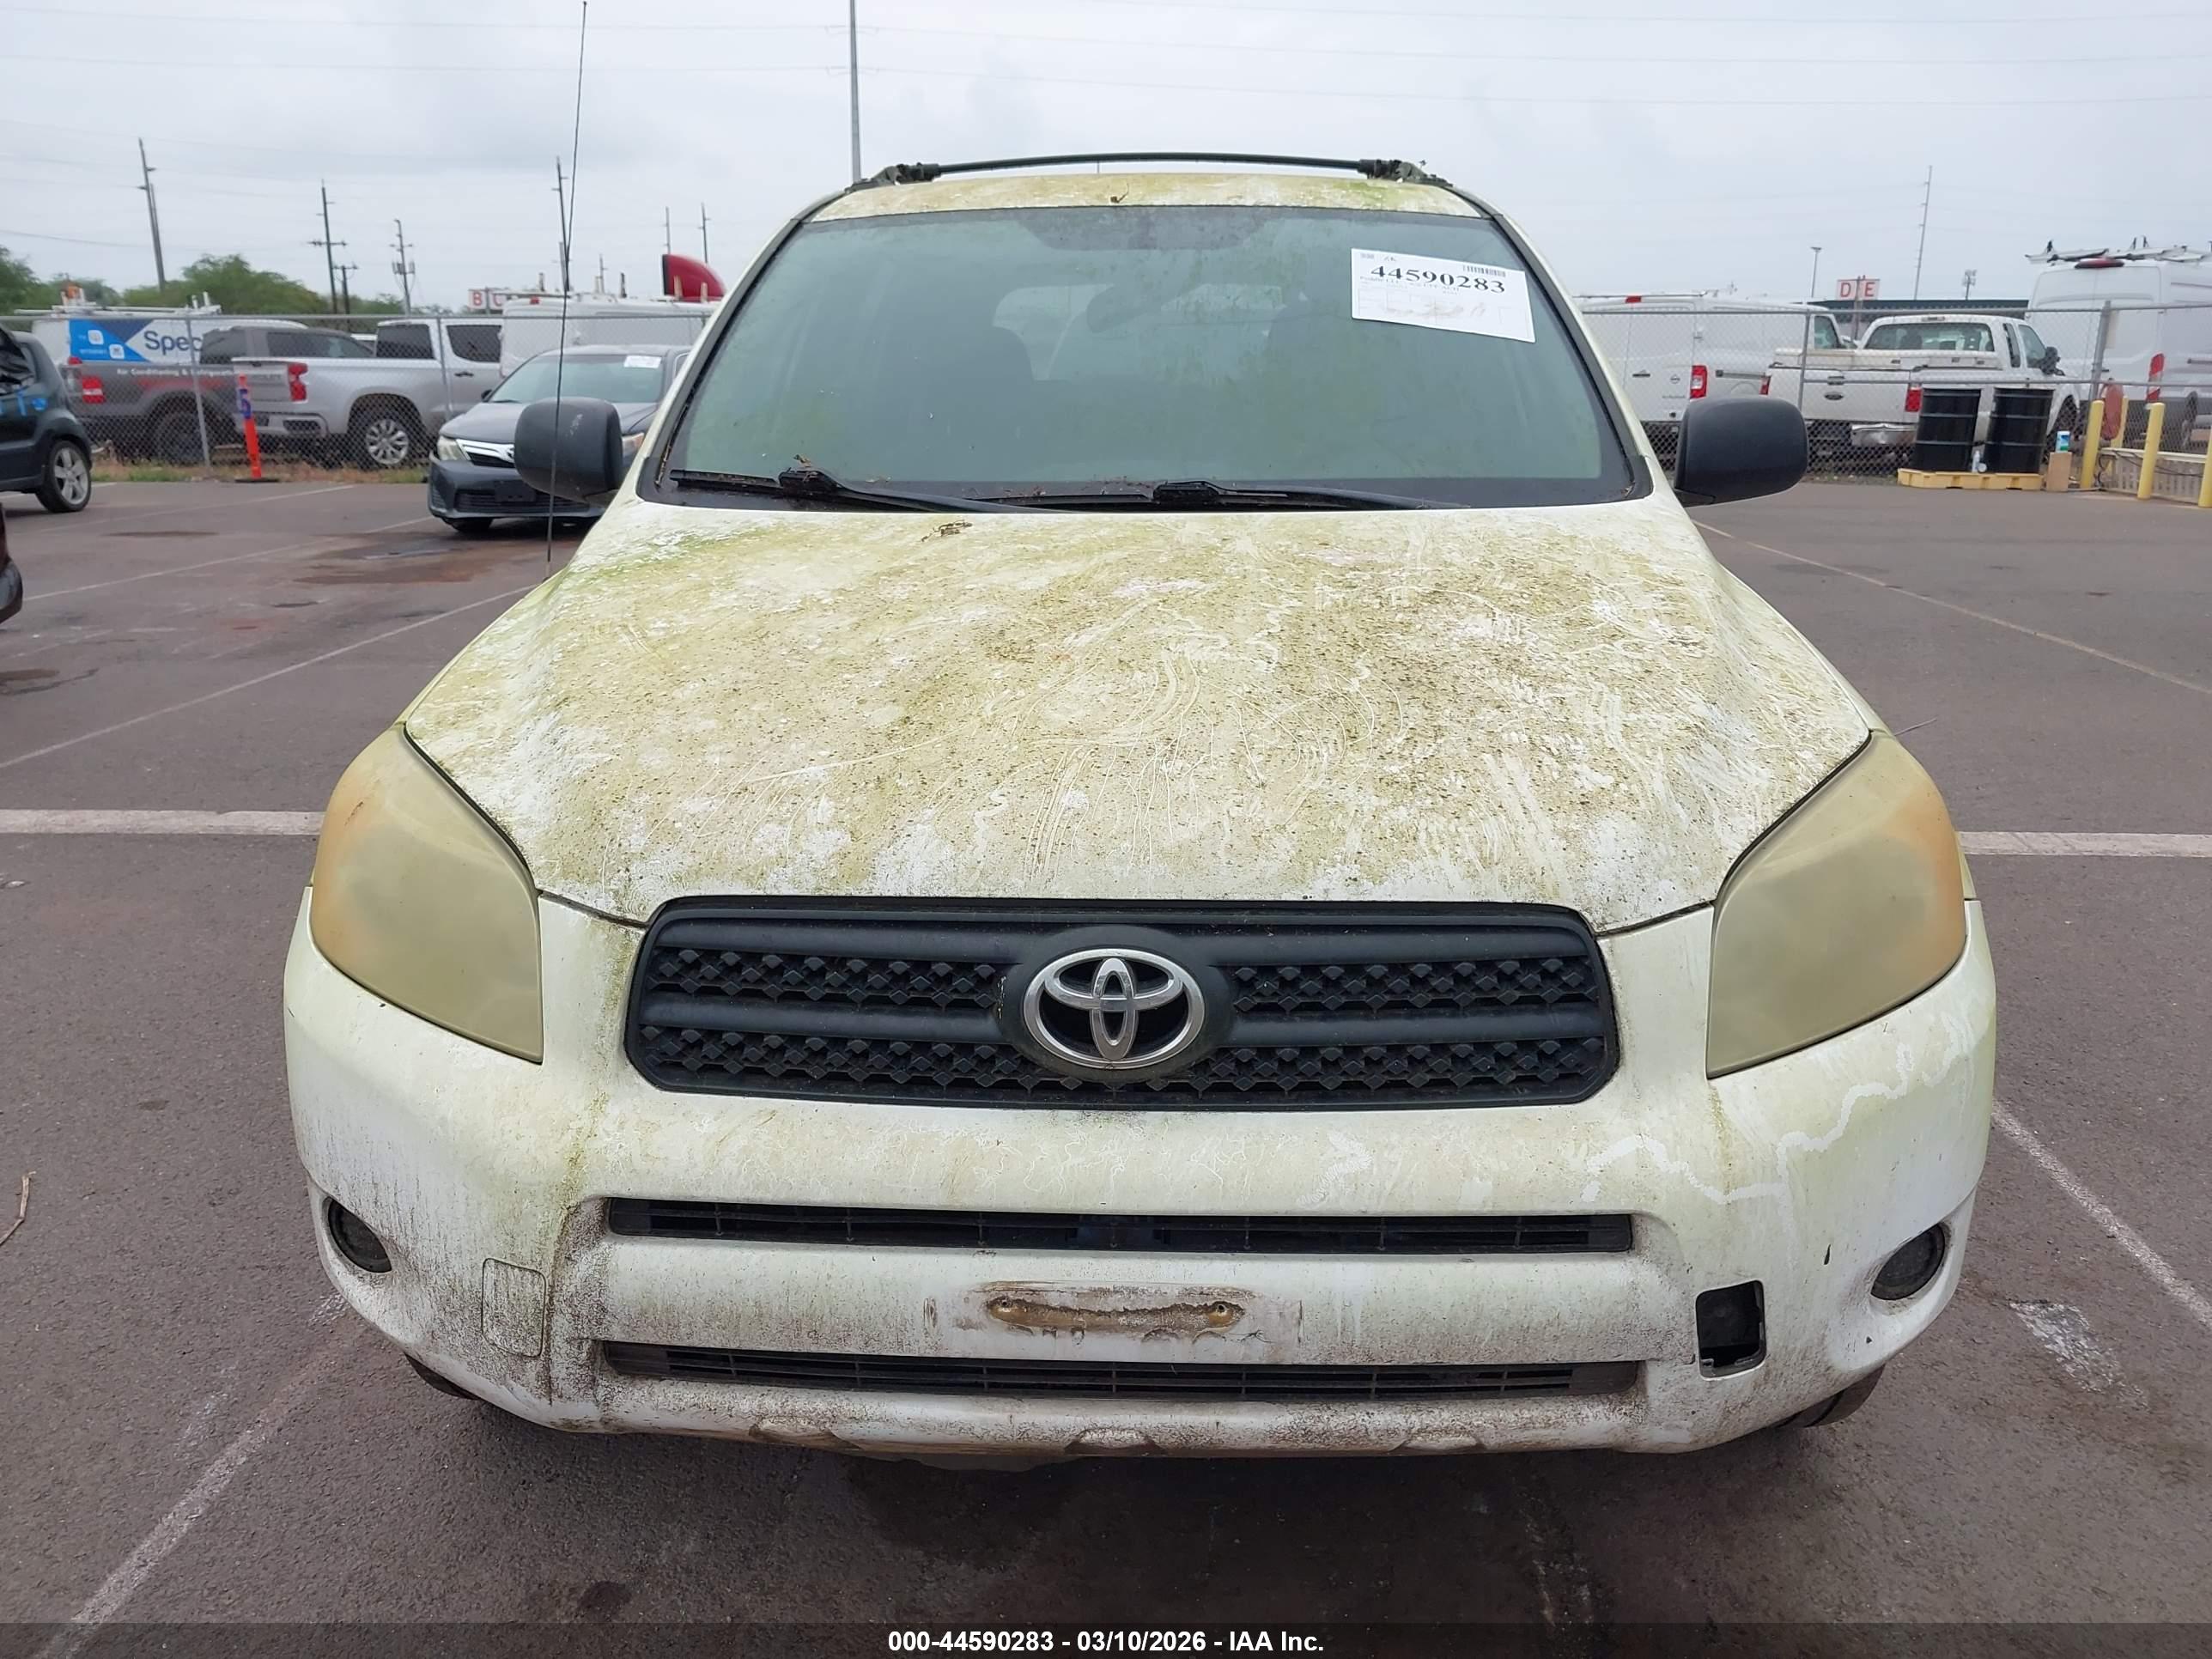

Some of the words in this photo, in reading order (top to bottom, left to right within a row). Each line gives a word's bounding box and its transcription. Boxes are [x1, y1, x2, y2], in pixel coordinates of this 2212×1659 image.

[1370, 265, 1506, 294] 44590283
[1840, 281, 1851, 298] D
[1864, 281, 1876, 297] E
[472, 290, 483, 307] B
